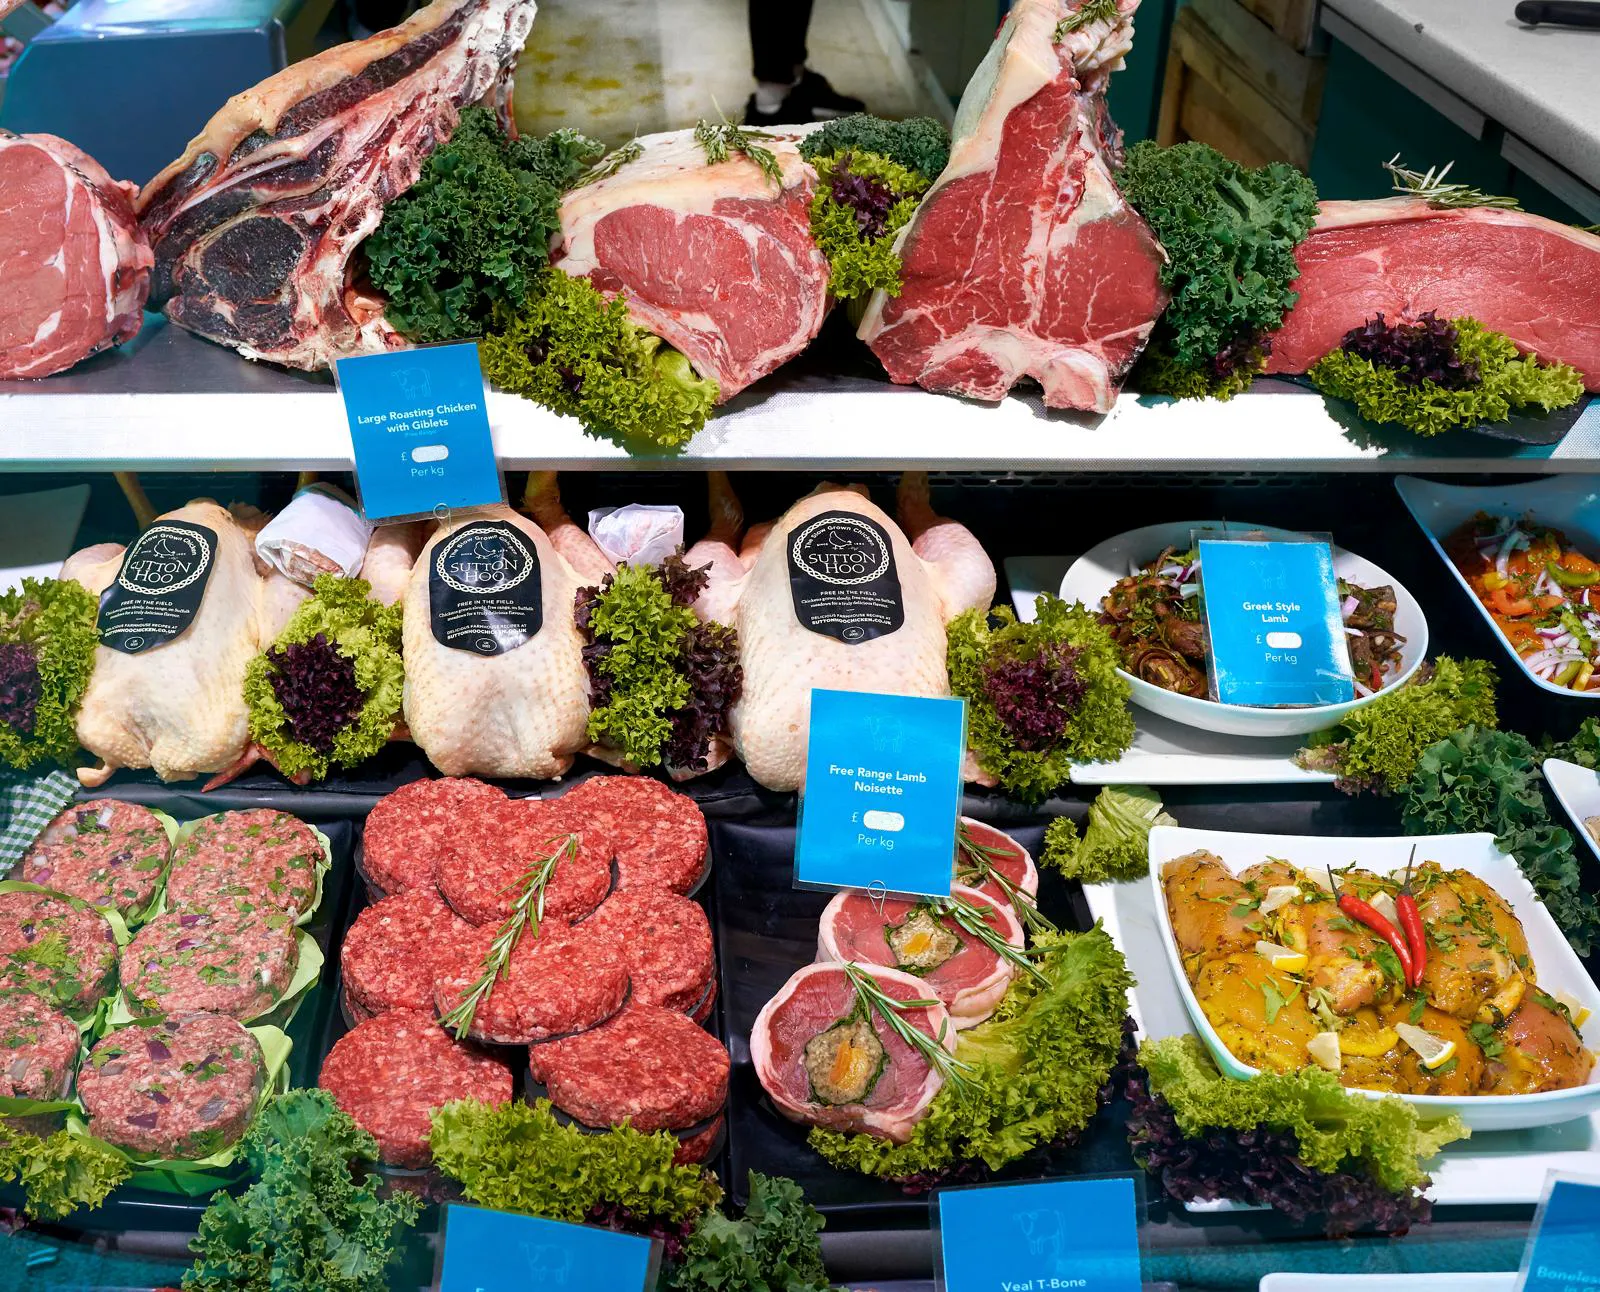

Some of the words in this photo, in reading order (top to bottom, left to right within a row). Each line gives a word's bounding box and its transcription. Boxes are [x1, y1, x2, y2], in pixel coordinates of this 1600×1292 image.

[358, 413, 387, 425] Large
[389, 408, 434, 421] Roasting
[436, 402, 477, 414] Chicken
[387, 423, 410, 433] with
[412, 418, 449, 431] Giblets
[401, 451, 407, 461] £
[411, 468, 428, 476] Per
[431, 466, 444, 476] kg
[160, 533, 183, 541] Grown
[811, 529, 826, 538] Slow
[853, 527, 875, 546] Chicken
[457, 538, 473, 548] Slow
[808, 550, 876, 564] SUTTON
[450, 557, 518, 572] SUTTON
[825, 562, 865, 574] HOO
[134, 569, 174, 583] HOO
[465, 571, 505, 582] HOO
[121, 599, 134, 607] FREE
[1243, 602, 1273, 611] Greek
[1275, 602, 1301, 613] Style
[1261, 614, 1289, 623] Lamb
[446, 624, 470, 635] DELICIOUS
[1256, 635, 1262, 644] £
[1265, 653, 1281, 662] Per
[1285, 652, 1297, 664] kg
[829, 765, 854, 776] Free
[857, 767, 892, 781] Range
[896, 771, 927, 783] Lamb
[854, 781, 903, 795] Noisette
[851, 812, 859, 823] £
[858, 834, 877, 846] Per
[880, 836, 894, 850] kg
[1537, 1266, 1600, 1284] Boneles
[1001, 1279, 1033, 1292] Veal
[1036, 1278, 1087, 1290] T-Bone
